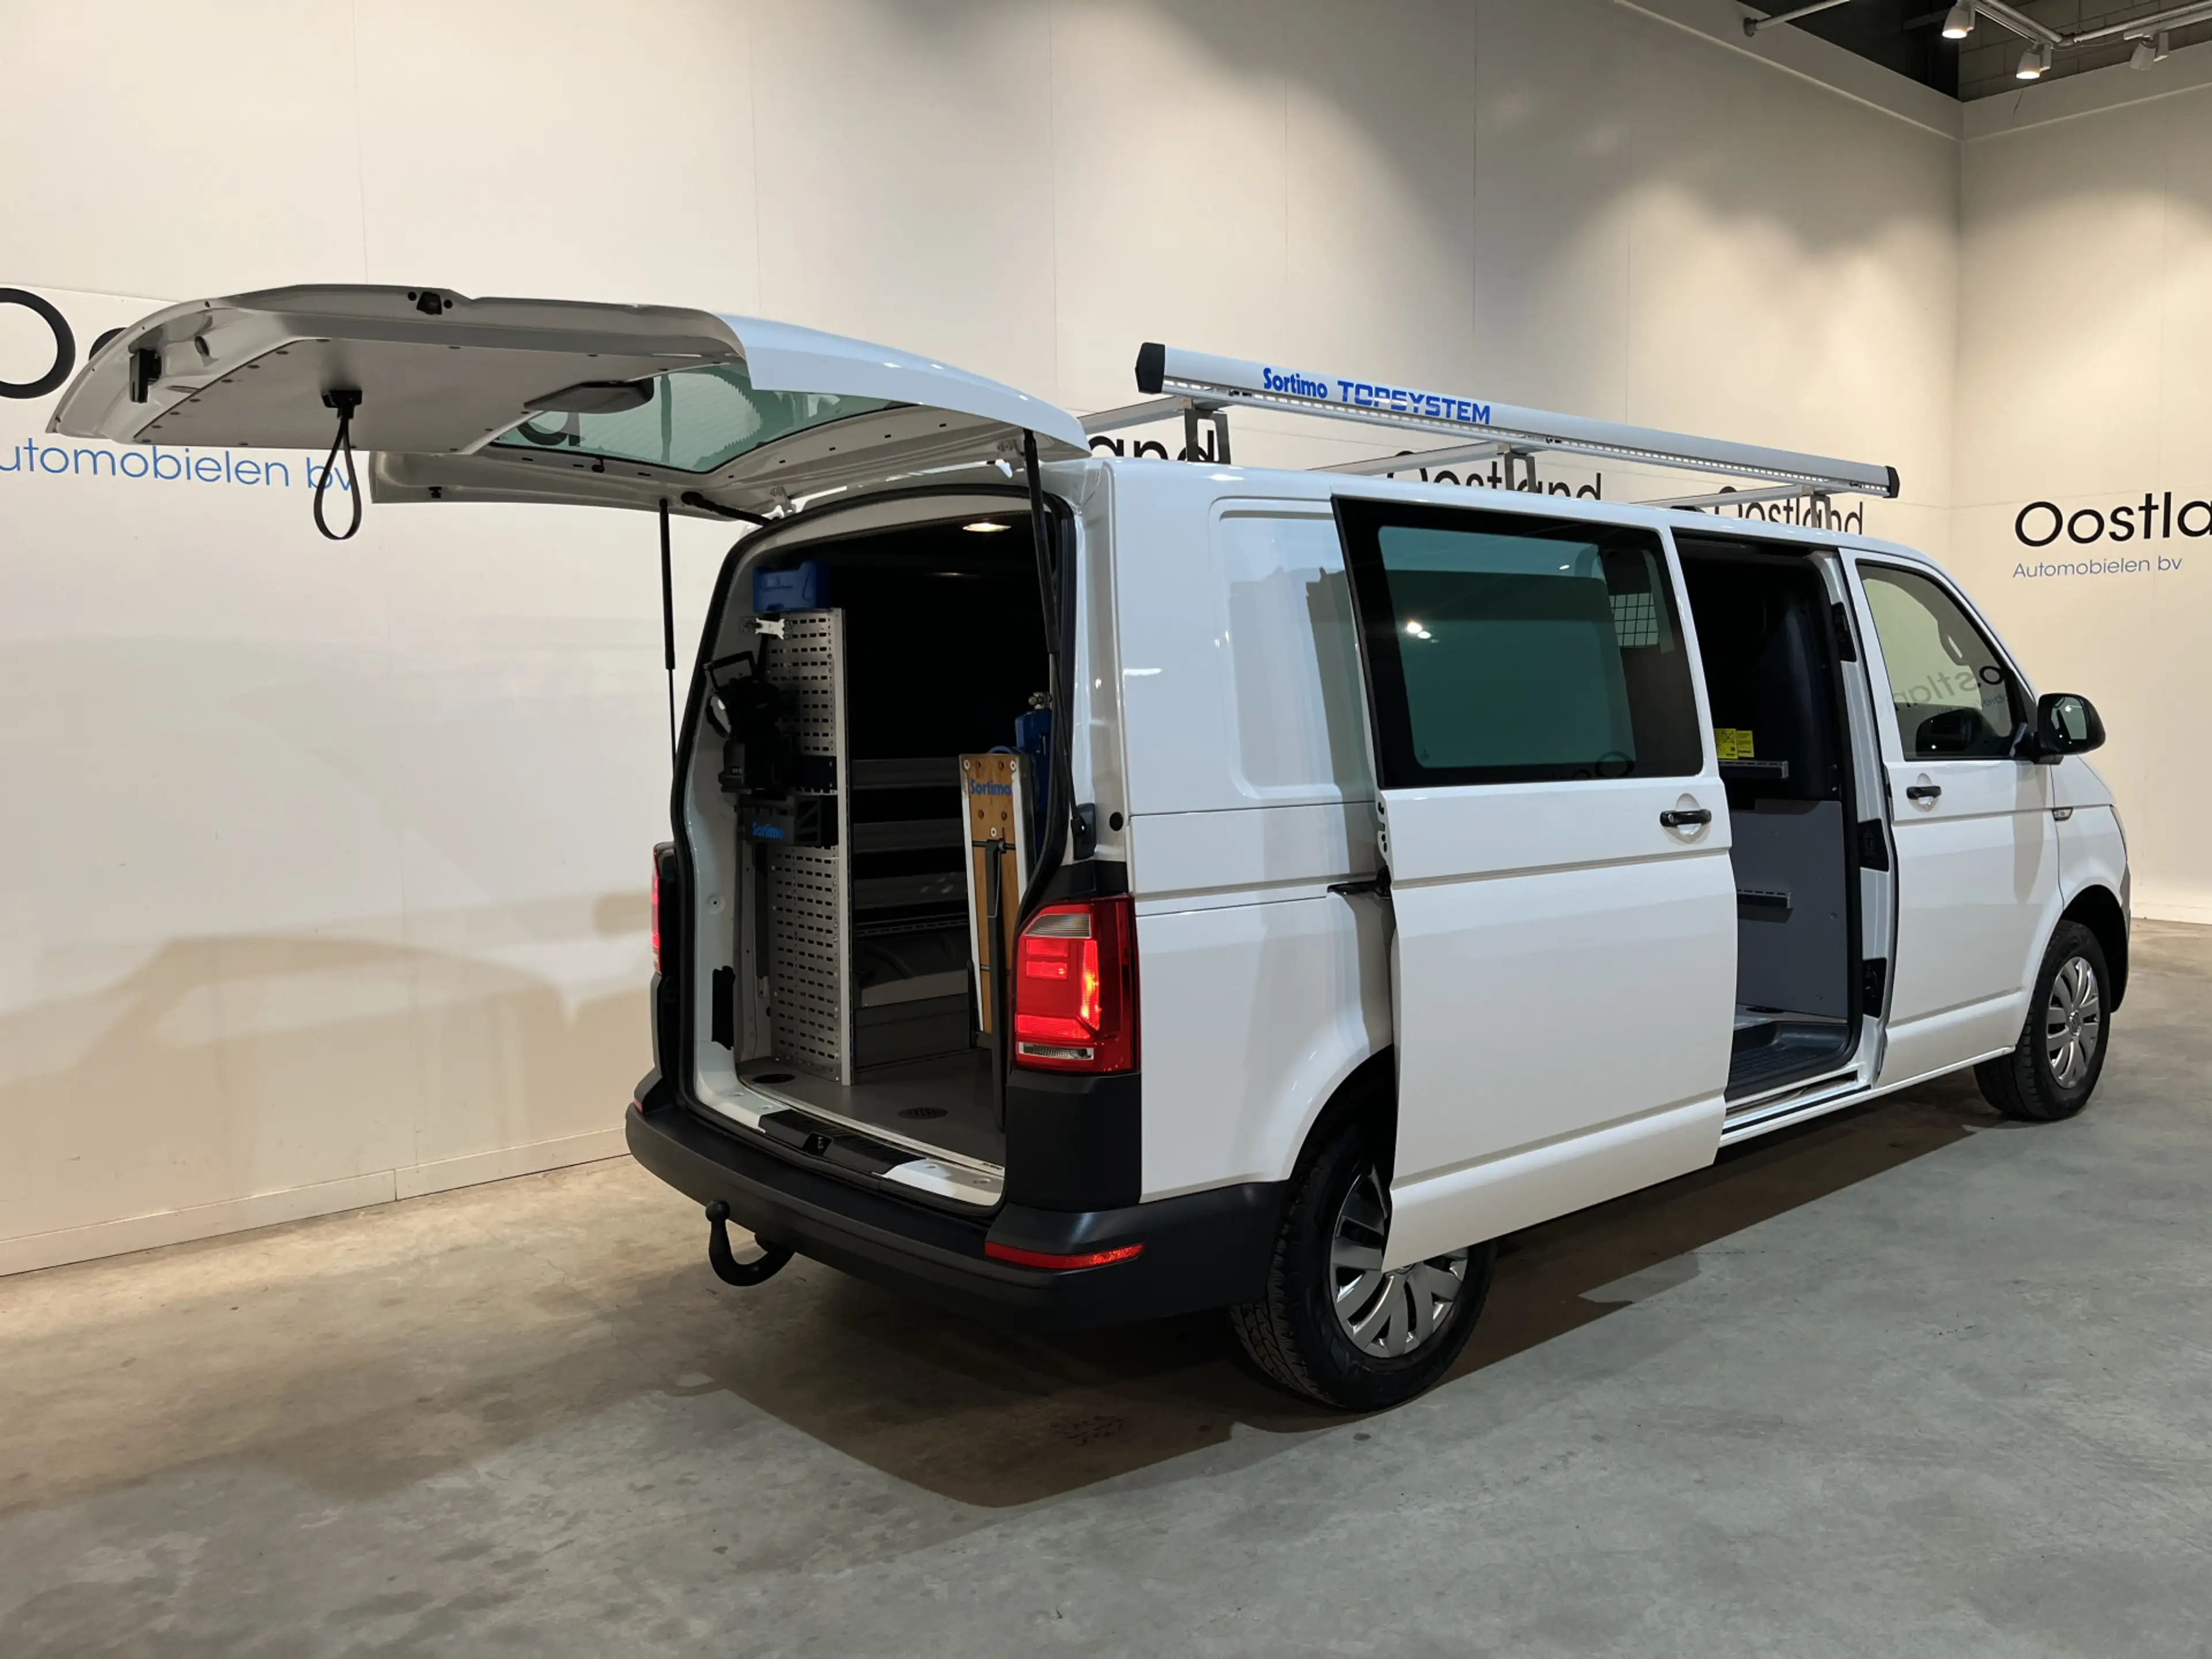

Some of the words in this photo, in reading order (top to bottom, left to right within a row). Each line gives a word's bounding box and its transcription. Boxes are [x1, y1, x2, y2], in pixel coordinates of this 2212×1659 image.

[1263, 368, 1328, 399] Sortimo
[1338, 380, 1491, 425] TOPSYSTEM
[306, 457, 353, 491] bv
[2013, 557, 2150, 578] Automobielen
[2157, 555, 2183, 571] bv
[970, 778, 1013, 796] Sortimo
